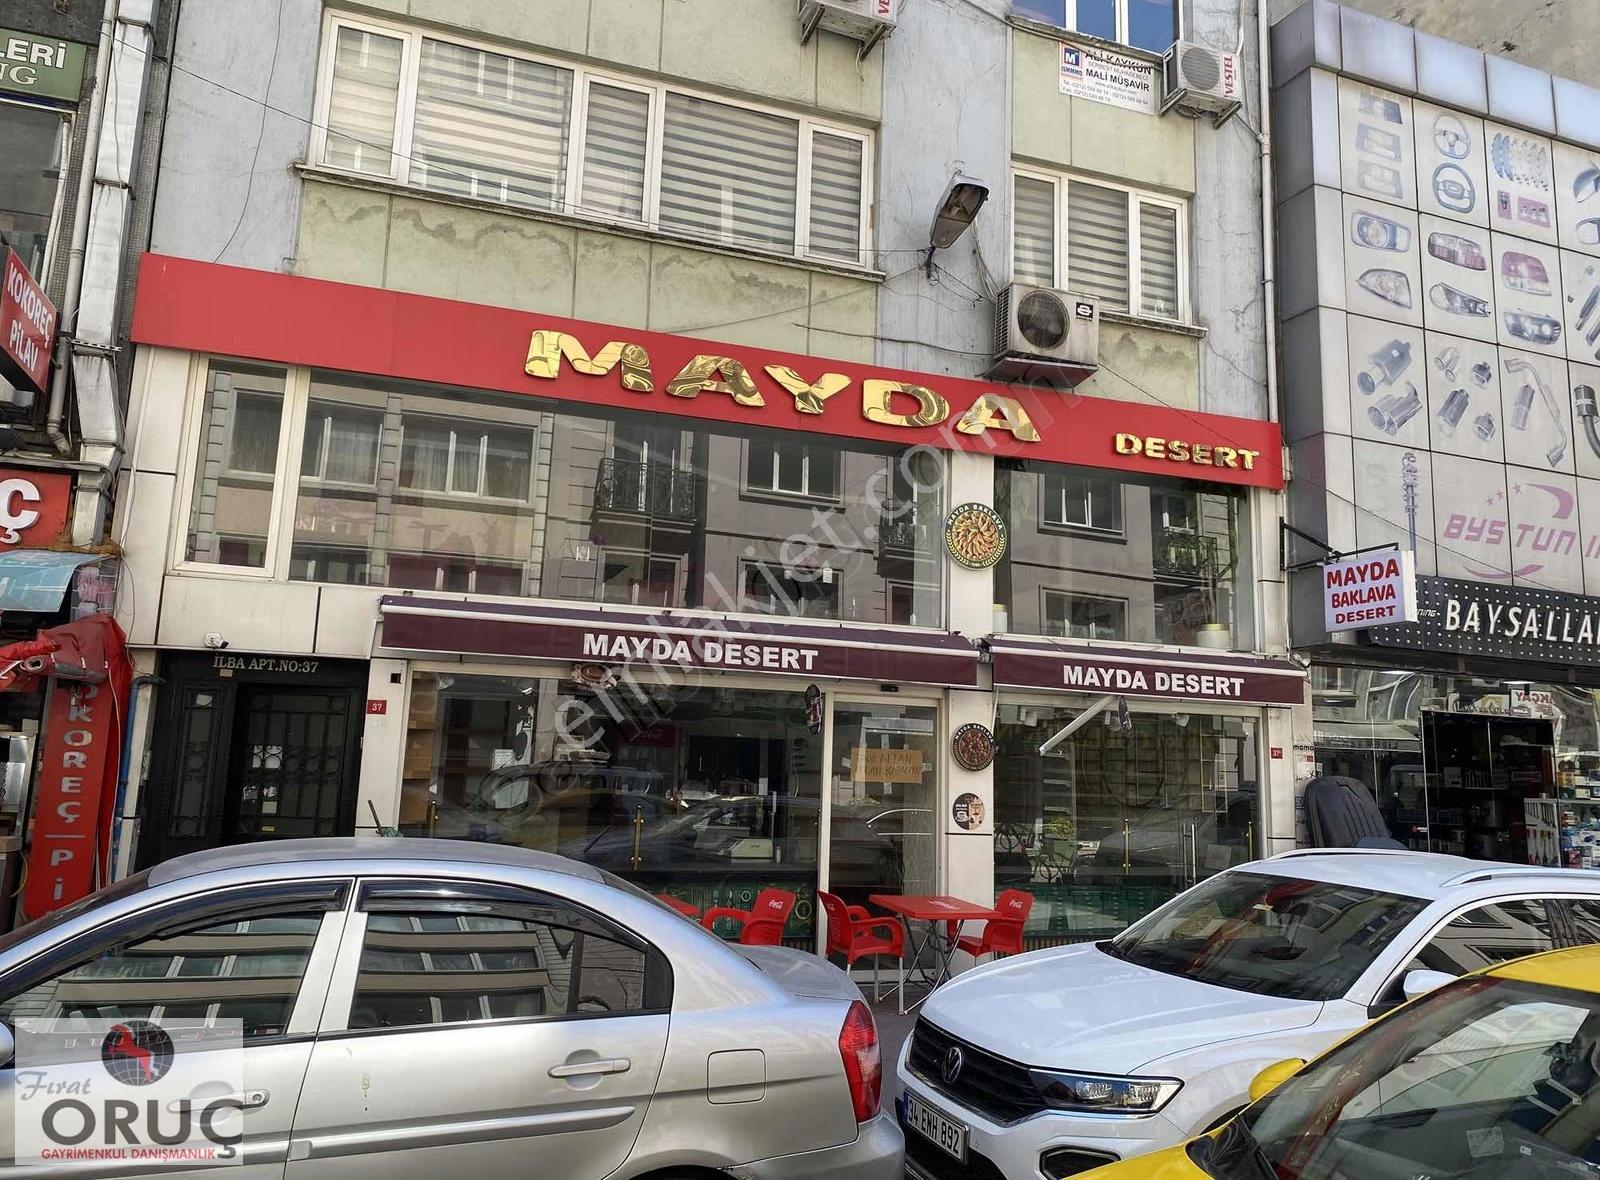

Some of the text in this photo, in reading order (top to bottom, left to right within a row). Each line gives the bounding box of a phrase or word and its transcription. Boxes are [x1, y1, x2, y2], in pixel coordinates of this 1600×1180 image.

[0, 38, 67, 69] ERİ
[1085, 68, 1108, 81] MALİ
[1110, 74, 1150, 92] MÜŞAVİR
[1223, 55, 1234, 95] VESTEL
[7, 262, 52, 349] KOKOREÇ
[9, 319, 38, 372] PİLAV
[524, 329, 1042, 442] MAYDA
[1115, 432, 1260, 470] DESERT
[0, 478, 40, 544] Ç
[947, 504, 1003, 530] MAYDA BAKLAVA
[1443, 513, 1506, 545] BYS
[1326, 558, 1400, 589] MAYDA
[1331, 583, 1396, 609] BAKLAVA
[1335, 605, 1396, 624] DESERT
[1416, 599, 1600, 645] NING BAYSALLA
[583, 633, 819, 671] MAYDA DESERT
[1063, 665, 1245, 696] MAYDA DESERT
[372, 703, 383, 711] 37
[56, 683, 98, 824] KOREÇ
[908, 1100, 959, 1155] 34 ENH 892
